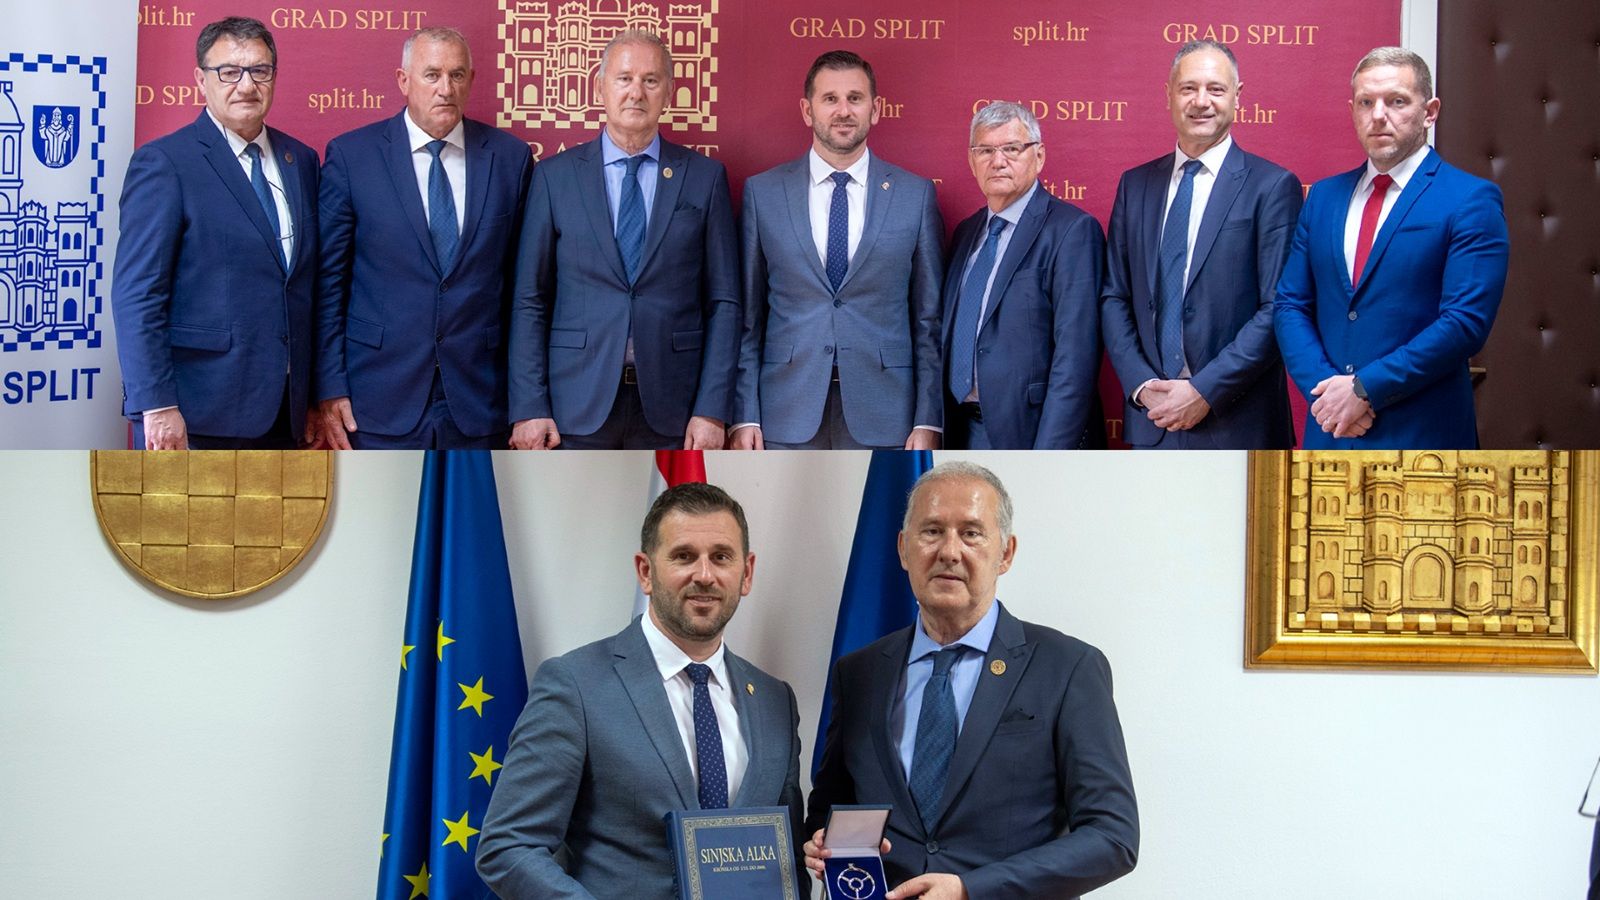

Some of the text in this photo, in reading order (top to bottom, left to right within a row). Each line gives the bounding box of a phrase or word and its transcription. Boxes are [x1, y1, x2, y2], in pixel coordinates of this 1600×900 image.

[137, 5, 196, 27] lit.hr
[271, 8, 427, 31] GRAD SPLIT
[790, 17, 946, 40] GRAD SPLIT
[1013, 20, 1090, 46] split.hr
[1163, 23, 1320, 46] GRAD SPLIT
[162, 85, 207, 106] SPL
[308, 88, 385, 114] split.hr
[1056, 100, 1128, 122] SPLIT
[1232, 103, 1277, 124] it.hr
[3, 367, 101, 404] SPLIT
[701, 845, 777, 867] SINJSKA ALKA
